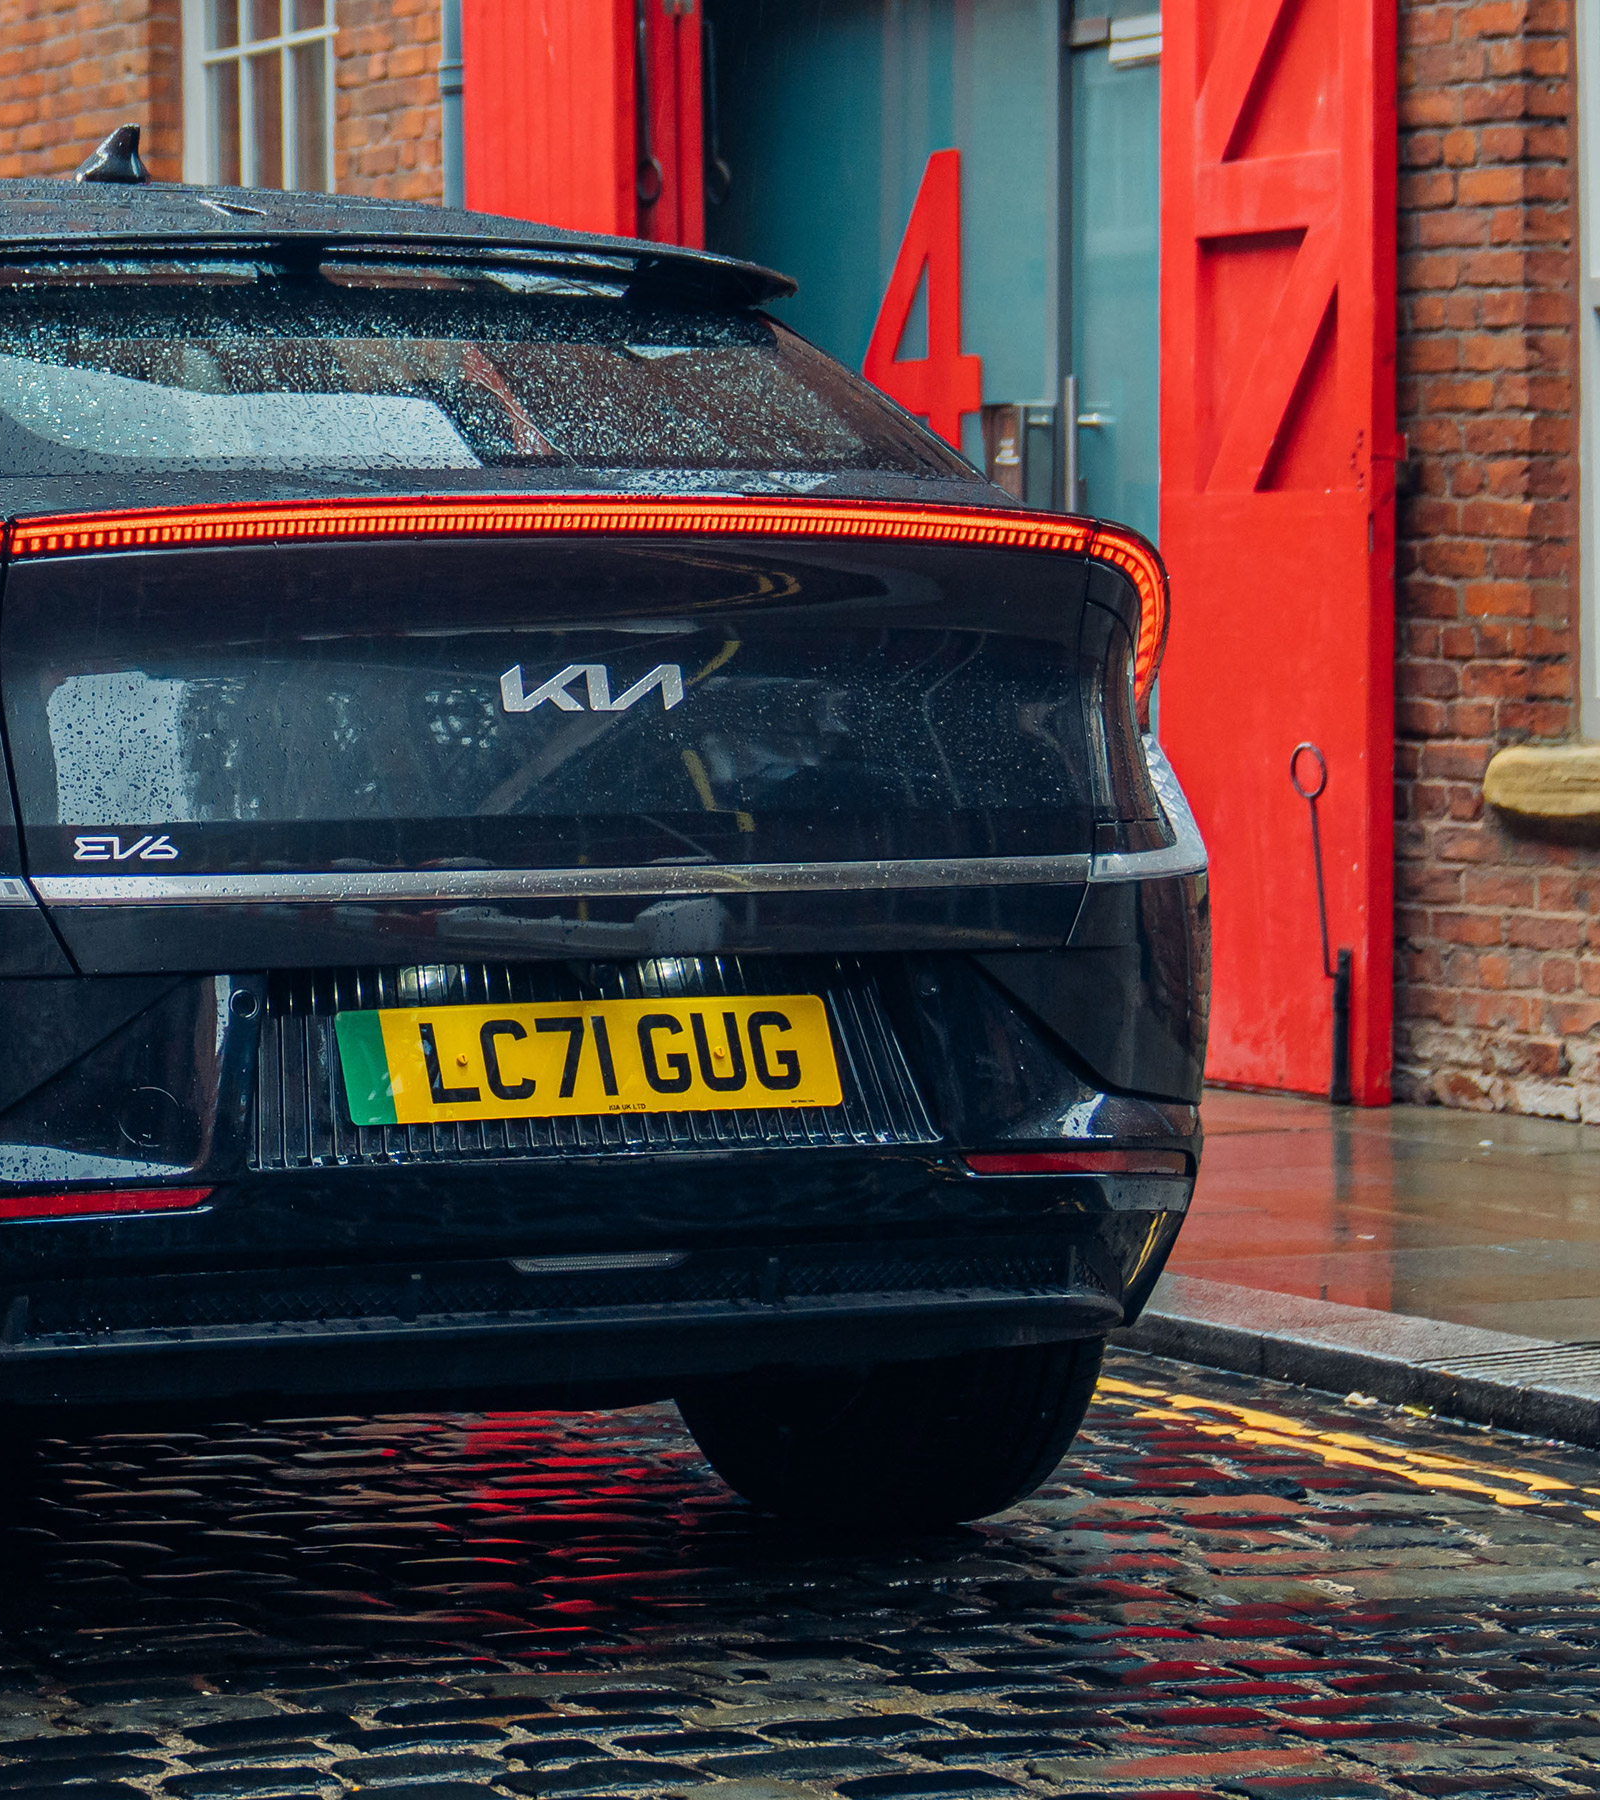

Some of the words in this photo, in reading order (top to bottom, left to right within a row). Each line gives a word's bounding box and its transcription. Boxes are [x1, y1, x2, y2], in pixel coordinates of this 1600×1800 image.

[862, 148, 982, 450] 4
[73, 836, 178, 860] EV6
[418, 1015, 619, 1104] LC71
[636, 1010, 801, 1094] GUG
